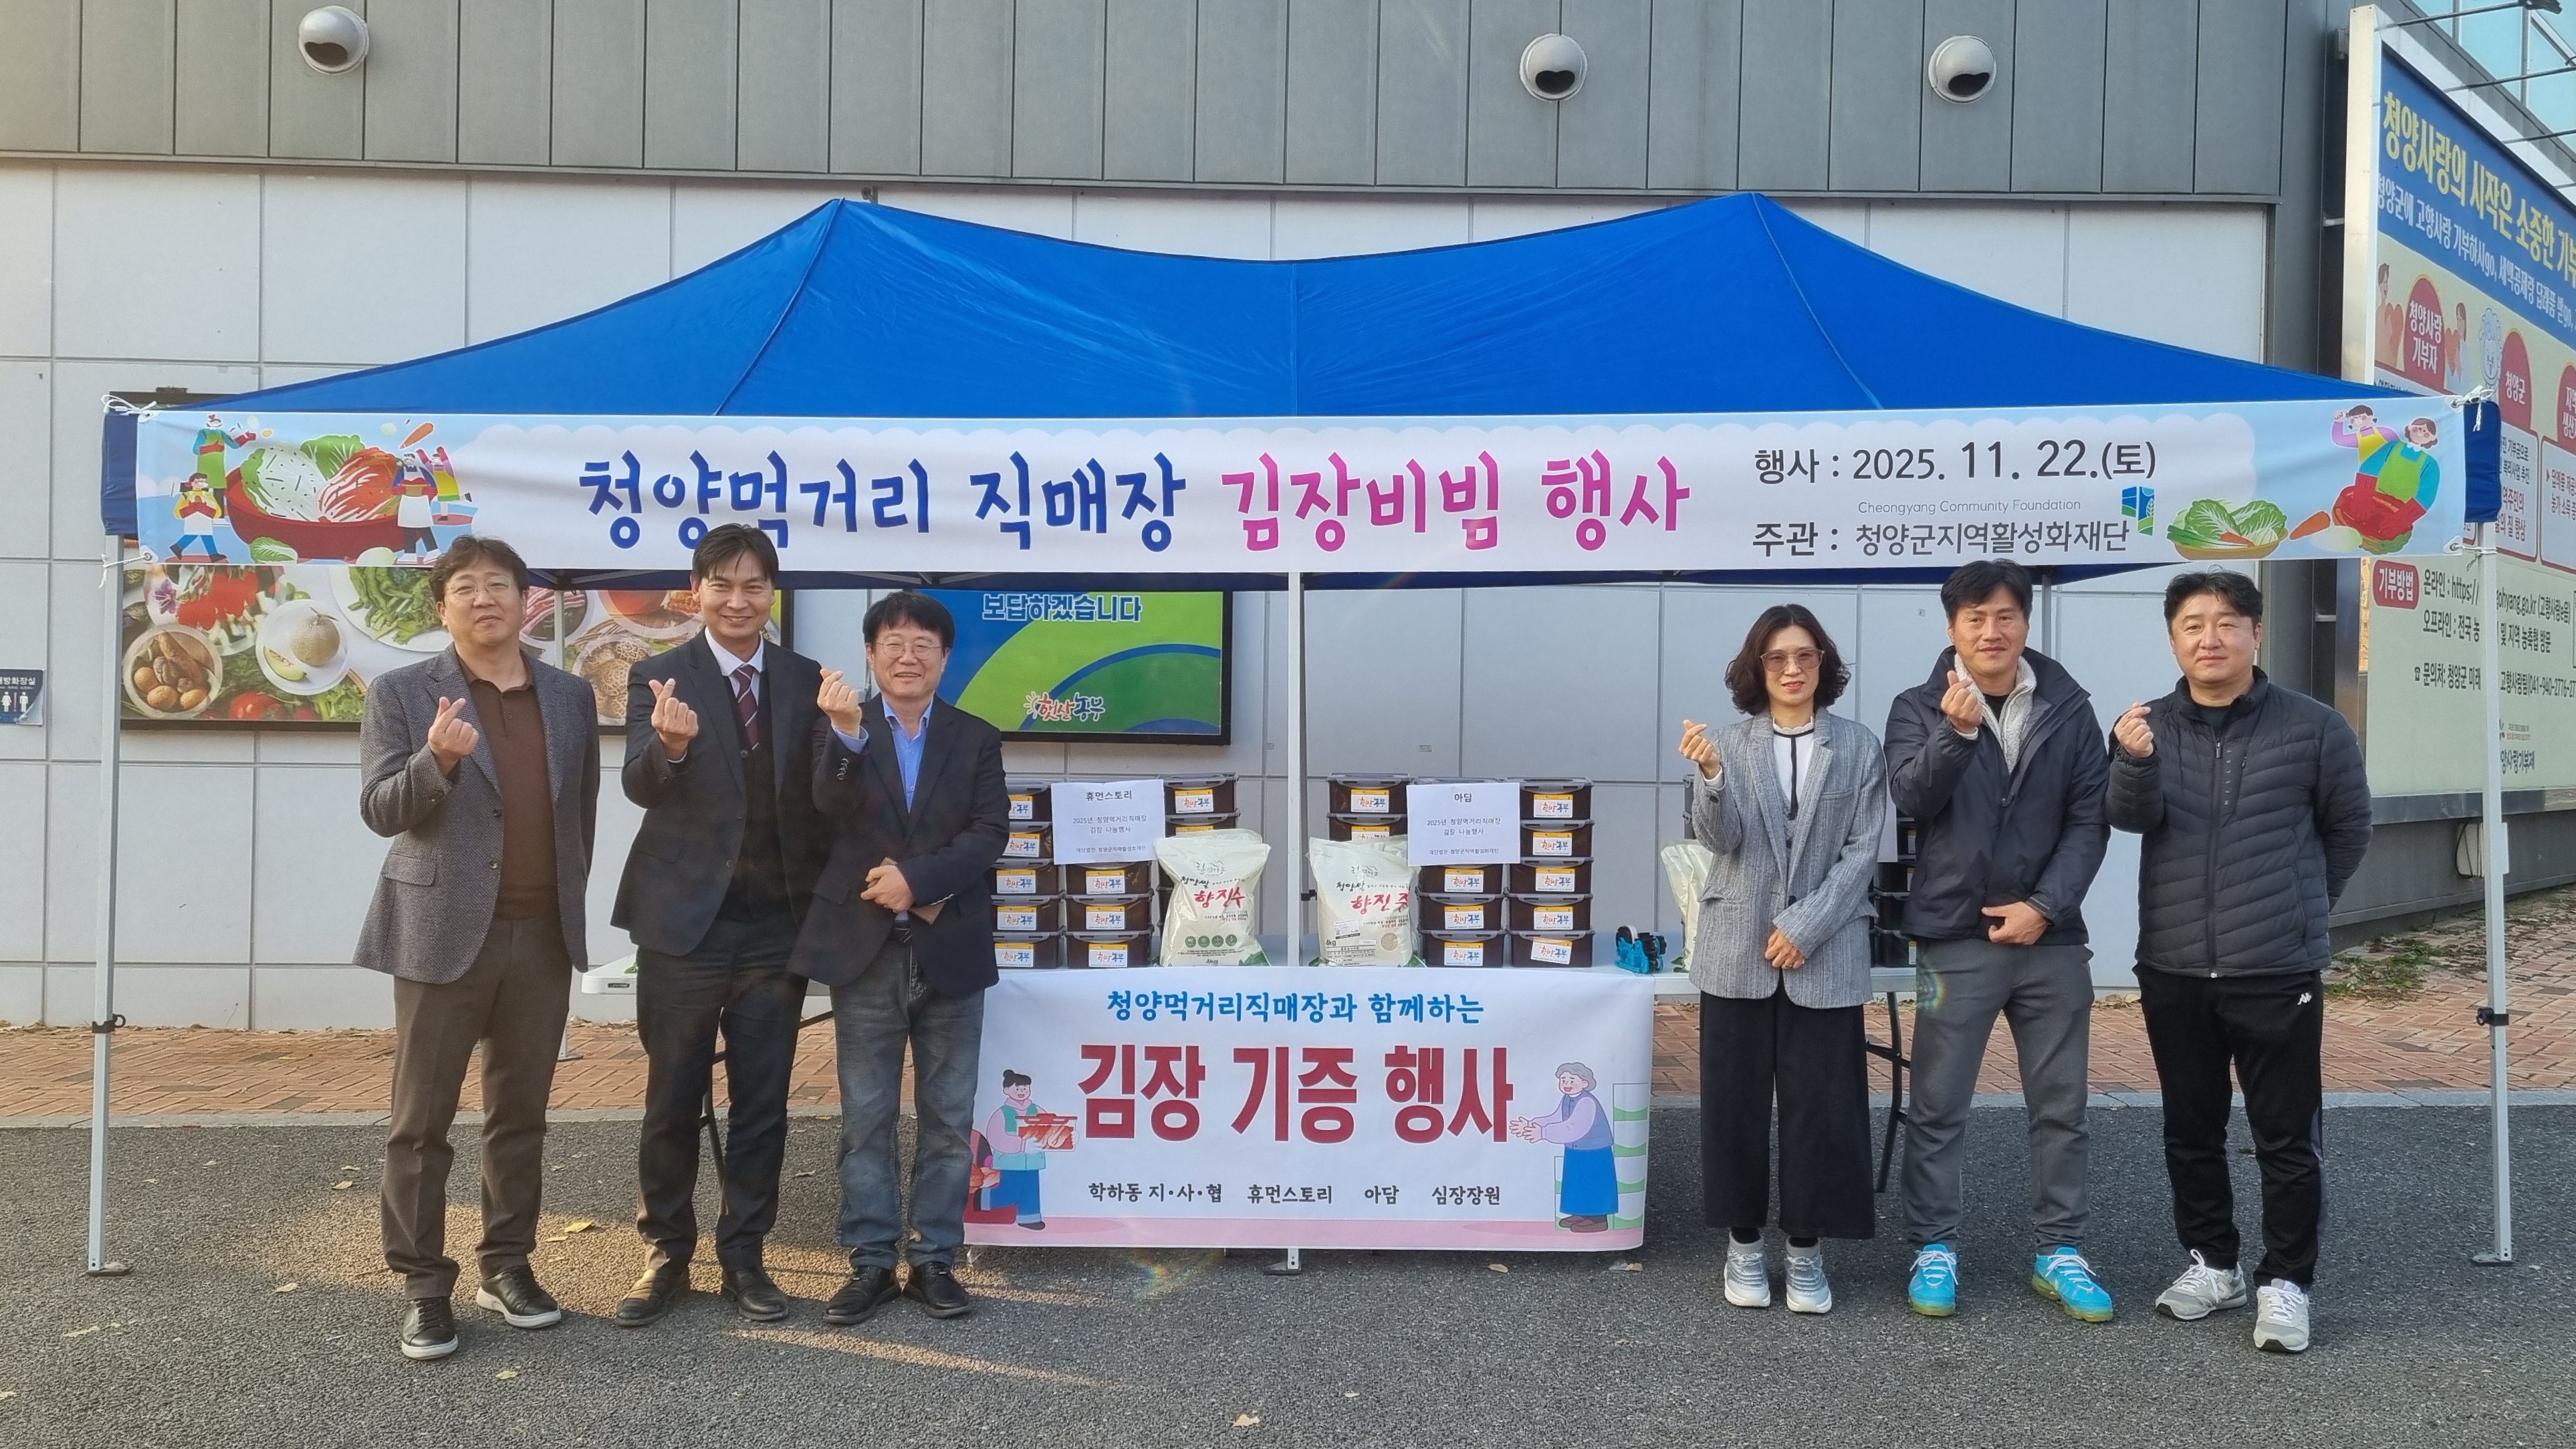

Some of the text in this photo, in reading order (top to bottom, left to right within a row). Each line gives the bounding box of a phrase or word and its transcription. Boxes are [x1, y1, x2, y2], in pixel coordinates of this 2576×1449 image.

[2383, 90, 2466, 207] 청양사랑의
[2470, 159, 2512, 240] 시작은
[2515, 199, 2555, 271] 소중한
[2377, 174, 2414, 227] 청양군에
[2416, 199, 2451, 249] 고향사랑
[2498, 255, 2535, 304] 세액공제랑
[2536, 282, 2556, 318] 답례품
[2409, 300, 2442, 344] 청양사랑
[2412, 336, 2438, 374] 기부자
[2506, 371, 2525, 405] 청양군
[1754, 449, 1820, 485] 행사
[1852, 449, 1946, 480] 2025.
[1960, 441, 2020, 481] 11.
[2036, 439, 2157, 480] 22.(토)
[579, 449, 1690, 552] 청양먹거리 직매장 김장비빔 행사
[1857, 497, 2081, 516] Cheongyang Community Foundation
[2502, 486, 2525, 515] 역주민의
[1752, 522, 1819, 557] 주관
[1855, 520, 2130, 556] 청양군지역활성화재단
[2379, 567, 2414, 602] 기부방법
[2424, 568, 2445, 598] 온라인
[983, 594, 1143, 623] 보답하겠습니다
[2423, 609, 2452, 638] 오프라인
[2458, 615, 2471, 641] 전국
[2508, 624, 2520, 649] 지역
[2423, 662, 2446, 688] 문의처:
[2448, 664, 2467, 689] 청양군
[1037, 692, 1105, 721] 햇살농부
[2500, 749, 2535, 774] 양사랑기부제
[1086, 790, 1133, 801] 휴먼스토리
[1454, 793, 1473, 802] 아담
[1096, 815, 1147, 824] 청양먹거리직매장
[1107, 990, 1484, 1024] 청양먹거리직매장과 함께하는
[1078, 1044, 1514, 1144] 김장 기증 행사
[1088, 1183, 1143, 1203] 학하동
[1247, 1184, 1332, 1204] 휴먼스토리
[1364, 1185, 1399, 1205] 아담
[1431, 1186, 1501, 1206] 심장장원
